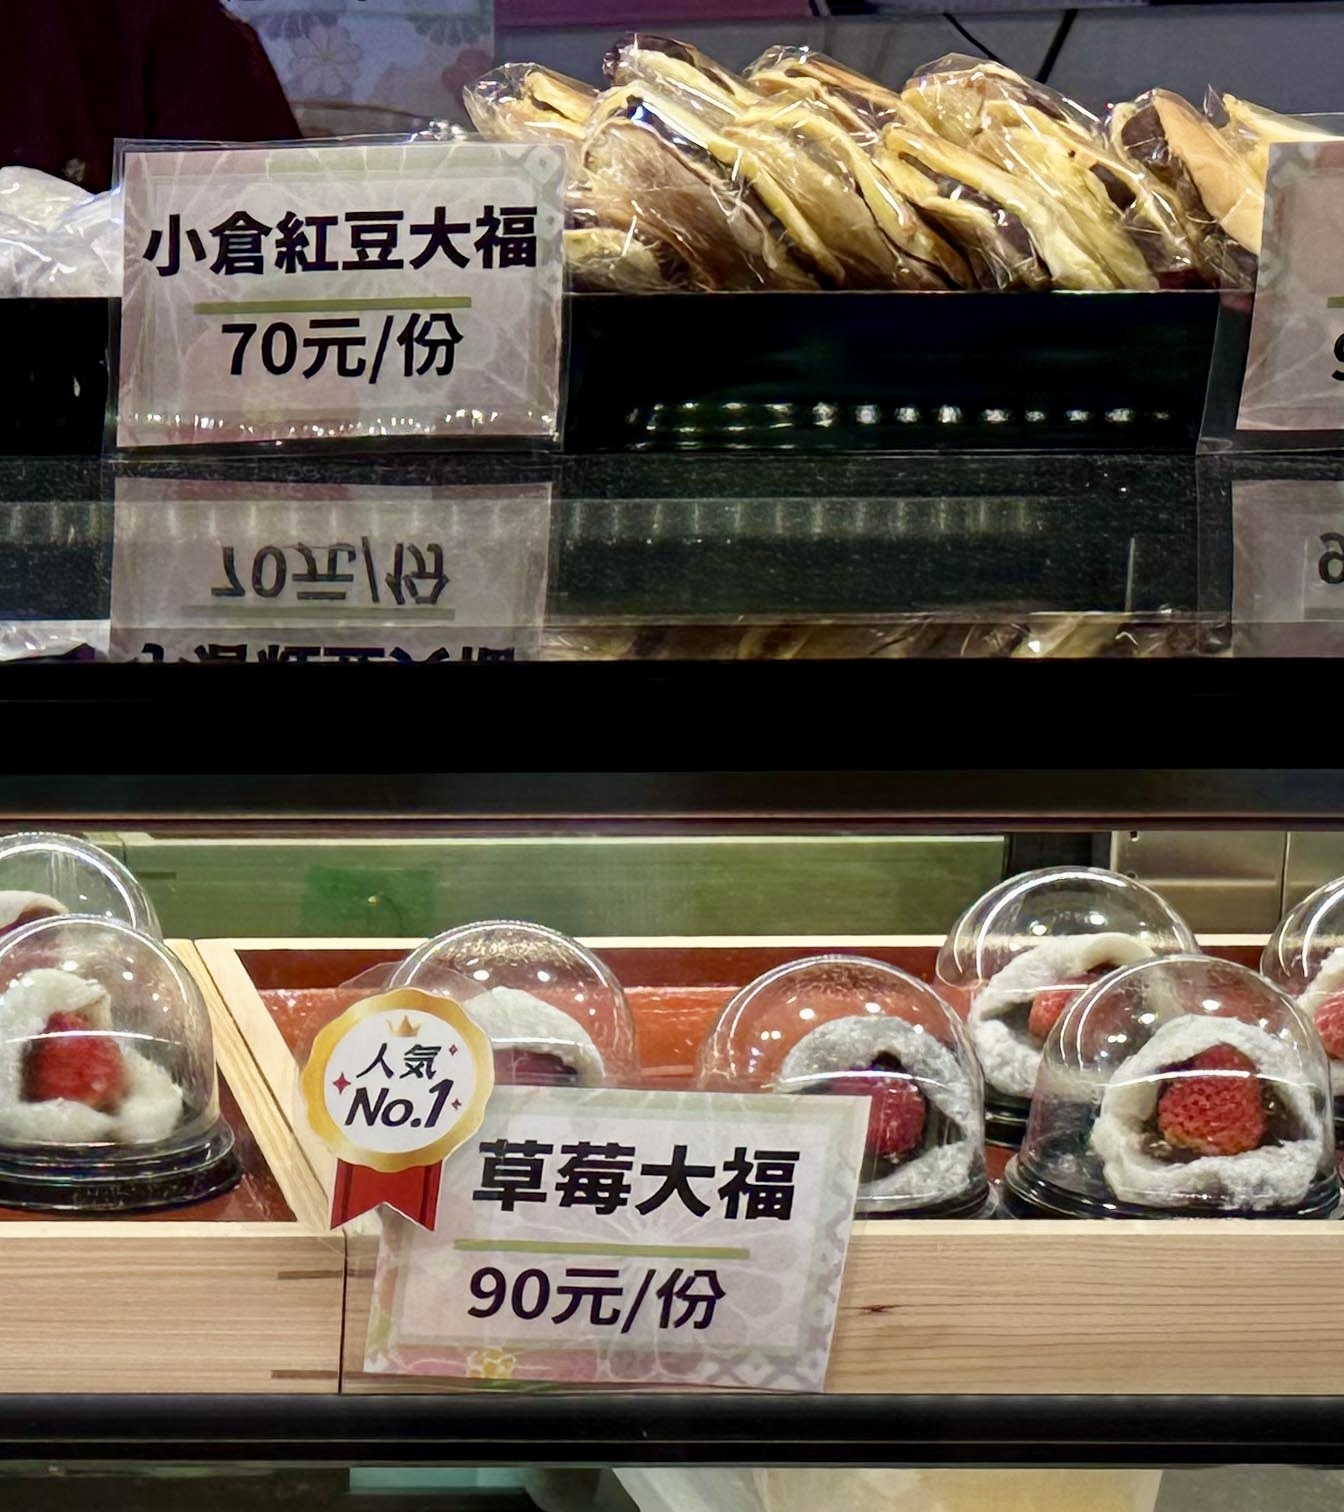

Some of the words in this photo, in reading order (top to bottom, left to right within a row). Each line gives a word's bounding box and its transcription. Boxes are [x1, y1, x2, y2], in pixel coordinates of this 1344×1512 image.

[143, 205, 538, 277] 小倉紅豆大福
[221, 312, 463, 384] 70元/份
[344, 1078, 454, 1128] No.1
[472, 1139, 801, 1220] 草莓大福
[468, 1267, 726, 1334] 90元/份
